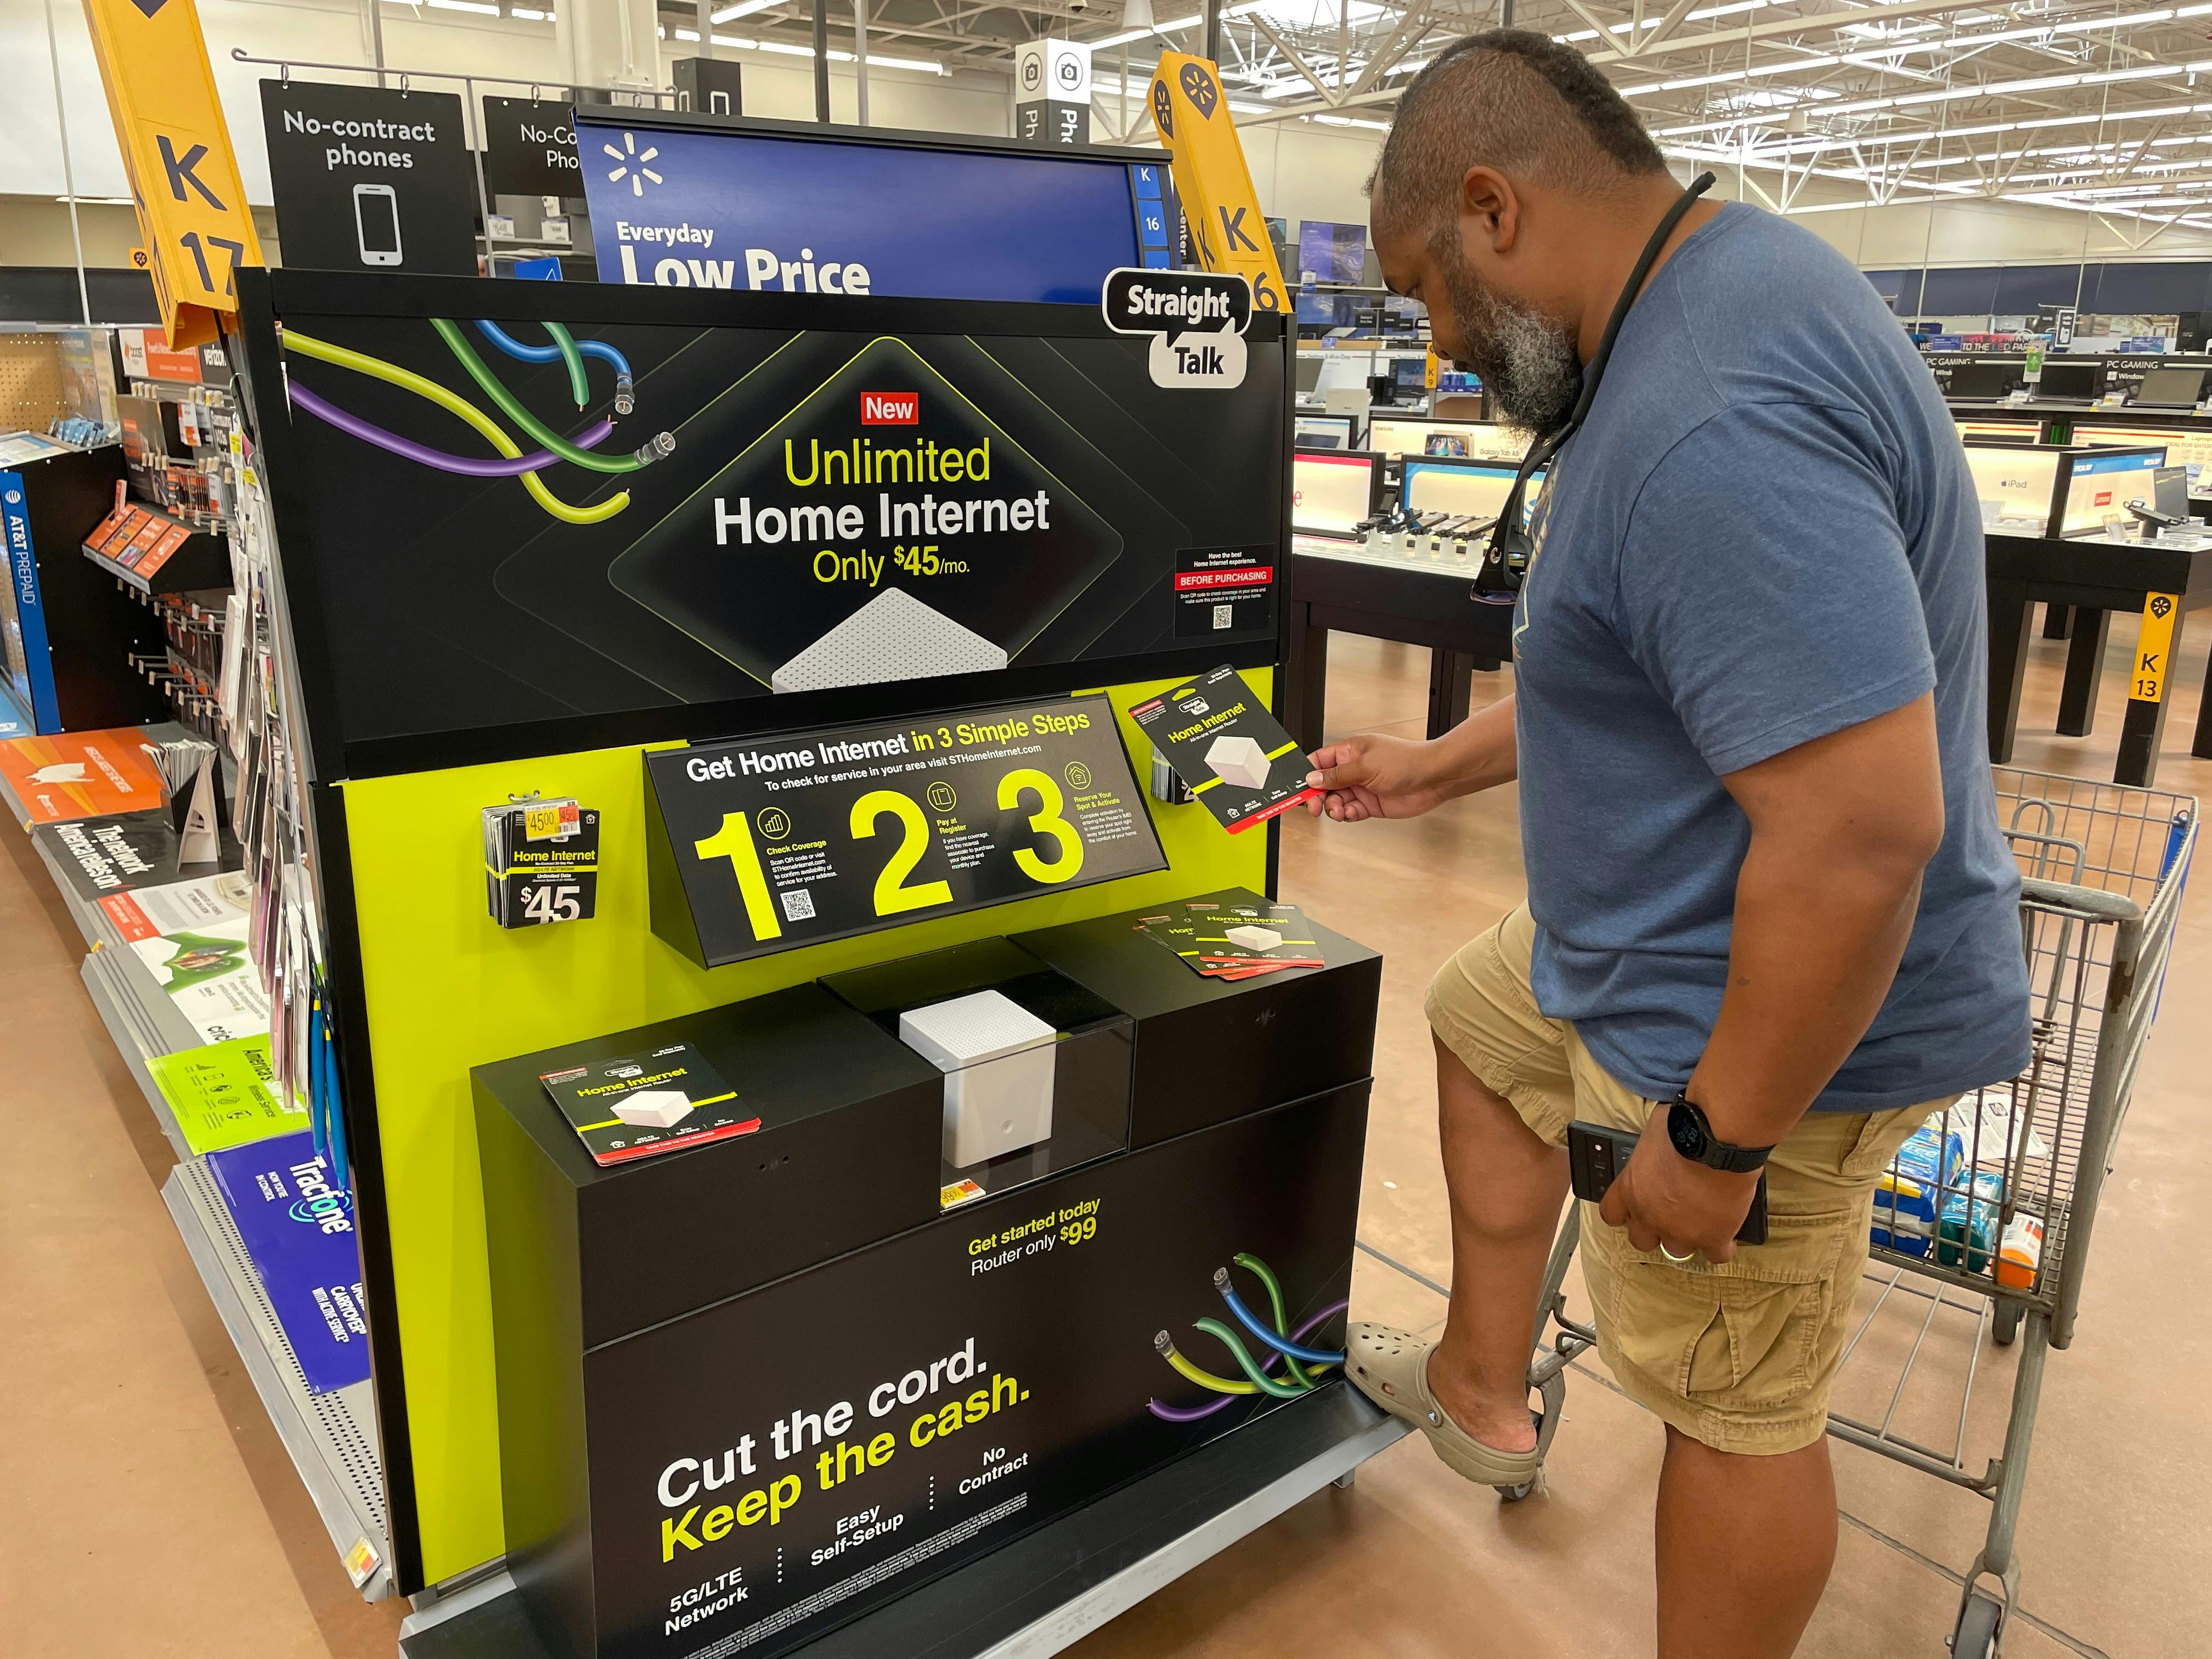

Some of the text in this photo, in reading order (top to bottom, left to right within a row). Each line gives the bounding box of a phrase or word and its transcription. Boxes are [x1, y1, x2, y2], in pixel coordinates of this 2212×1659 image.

[284, 110, 436, 142] No-contract
[521, 124, 577, 148] No-Co
[326, 144, 413, 170] phones
[548, 150, 579, 169] Pho
[156, 135, 228, 212] K
[1141, 168, 1151, 182] K
[617, 222, 714, 249] Everyday
[1146, 216, 1160, 231] 16
[1218, 205, 1260, 252] K
[180, 232, 244, 297] 17
[620, 245, 871, 296] Low Price
[1127, 285, 1230, 324] Straight
[1175, 346, 1224, 375] Talk
[2106, 360, 2158, 369] PC GAMING
[866, 397, 913, 420] New
[785, 437, 990, 487] Unlimited
[2007, 479, 2027, 489] iPad
[9, 515, 27, 550] AT&T
[714, 490, 1050, 545] Home Internet
[15, 551, 37, 606] PREPAID
[813, 544, 970, 588] Only $45/mo.
[1180, 571, 1267, 586] BEFORE PURCHASING
[2141, 653, 2160, 673] K
[2136, 679, 2157, 697] 13
[1167, 702, 1247, 744] Home Internet
[1223, 718, 1238, 727] Router
[686, 712, 1091, 783] Get Home Internet in 3 Simple Steps
[764, 743, 1042, 792] To check for service in your area visit STHomeInternet.com
[1074, 794, 1097, 803] Reserve
[1076, 803, 1090, 811] Spot
[1097, 798, 1120, 806] Activate
[92, 825, 125, 843] The
[939, 825, 967, 835] Register
[995, 769, 1085, 884] 3
[103, 839, 155, 875] network
[514, 850, 596, 862] Home Internet
[766, 839, 827, 856] Check Coverage
[770, 857, 784, 866] Scan
[849, 789, 954, 917] 2
[93, 874, 122, 890] on
[694, 810, 783, 941] 1
[776, 878, 795, 887] service
[803, 874, 815, 883] your
[816, 870, 838, 879] address.
[781, 870, 800, 879] confirm
[800, 865, 826, 877] availability
[520, 885, 580, 924] $45
[207, 1025, 238, 1041] cric
[576, 1067, 689, 1097] Home Internet
[289, 1155, 350, 1234] Tracfone
[968, 1198, 1101, 1256] Get started today
[971, 1216, 1097, 1277] Router only $99
[657, 1336, 988, 1508] Cut the cord.
[661, 1372, 1030, 1564] Keep the cash.
[983, 1446, 1006, 1467] No
[958, 1452, 1029, 1495] Contract
[836, 1504, 881, 1536] Easy
[810, 1513, 904, 1567] Self-Setup
[669, 1566, 743, 1614] 5G/LTE
[664, 1585, 749, 1636] Network
